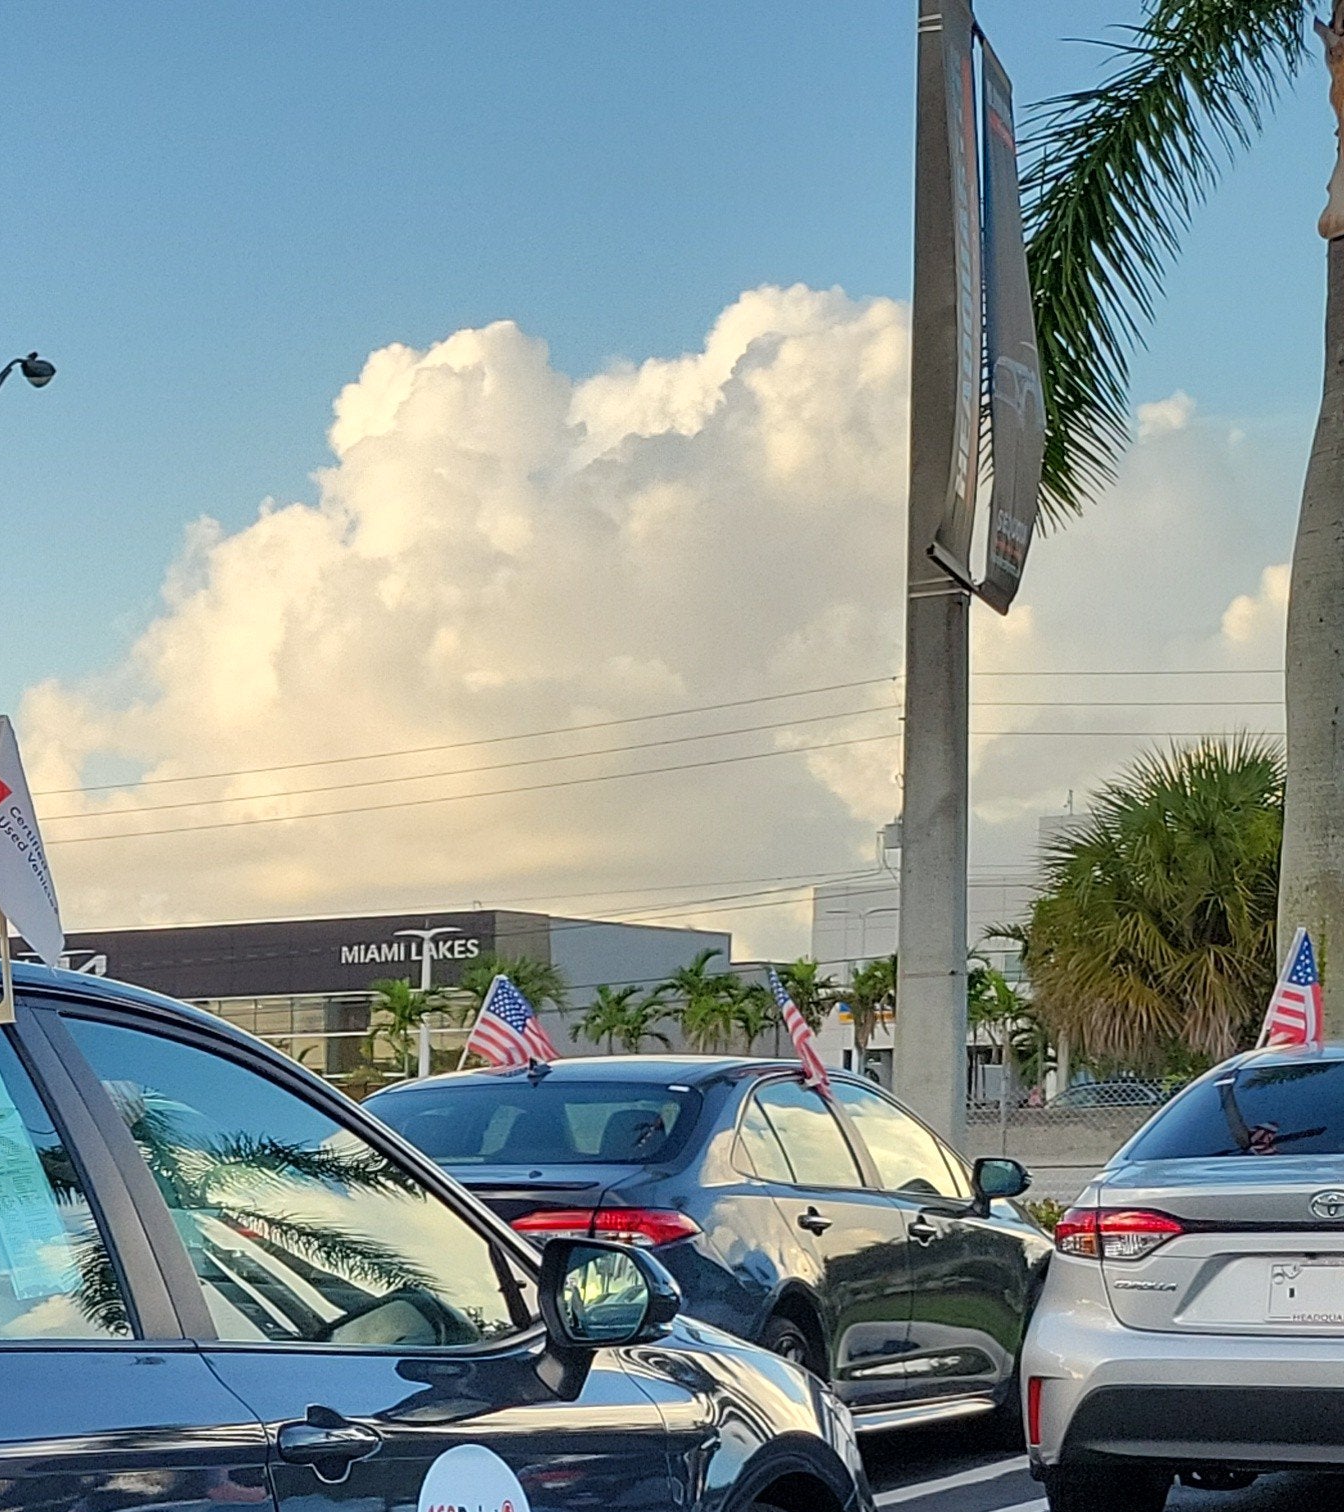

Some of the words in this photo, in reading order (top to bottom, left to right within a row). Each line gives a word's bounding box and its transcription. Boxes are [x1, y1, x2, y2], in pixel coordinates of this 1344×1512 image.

[10, 805, 48, 872] Certified
[341, 942, 404, 964] MIAMI
[411, 938, 479, 962] LAKES
